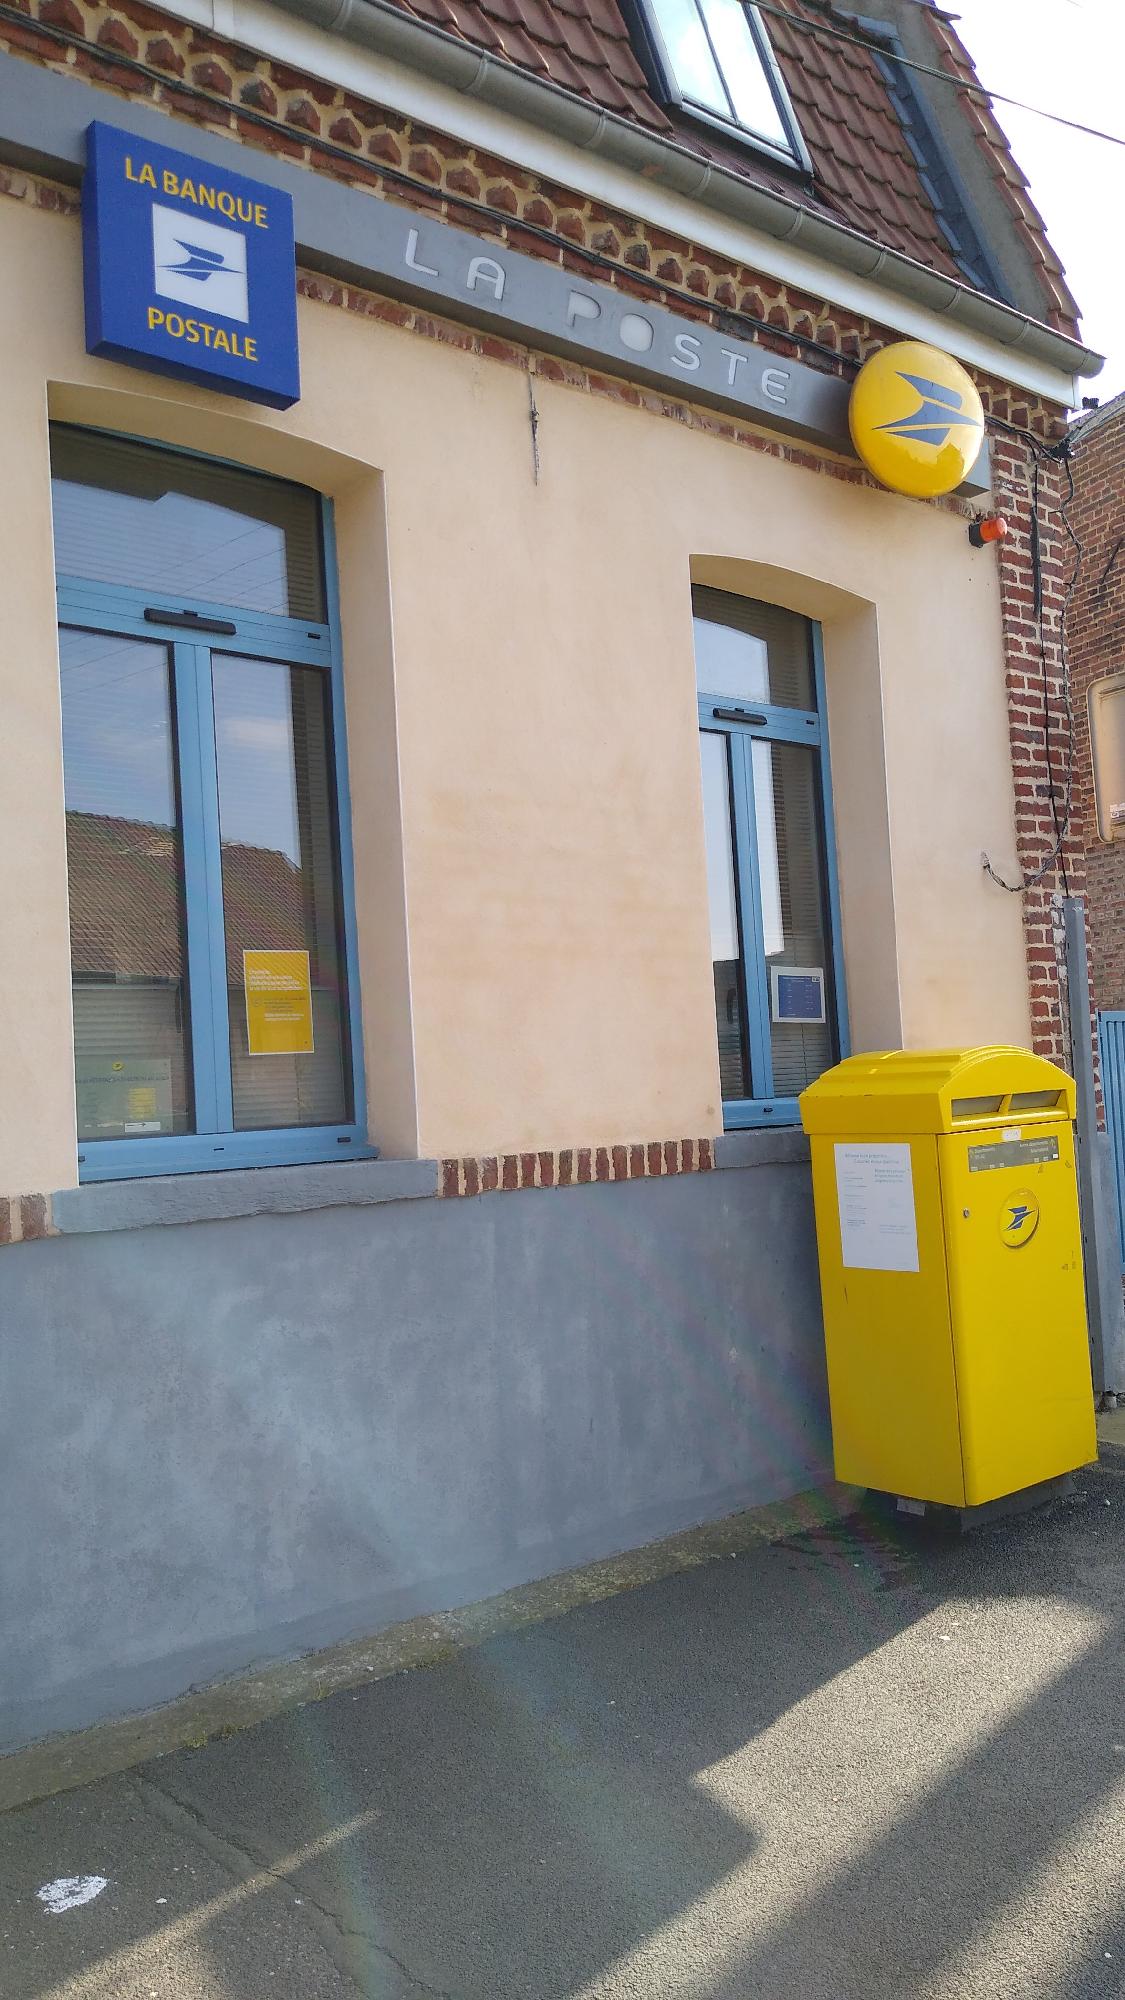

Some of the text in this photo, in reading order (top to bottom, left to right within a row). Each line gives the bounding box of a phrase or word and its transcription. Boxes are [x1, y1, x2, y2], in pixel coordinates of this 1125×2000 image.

[125, 157, 269, 229] LA BANQUE
[147, 306, 259, 362] POSTALE
[404, 229, 791, 405] LA POSTE
